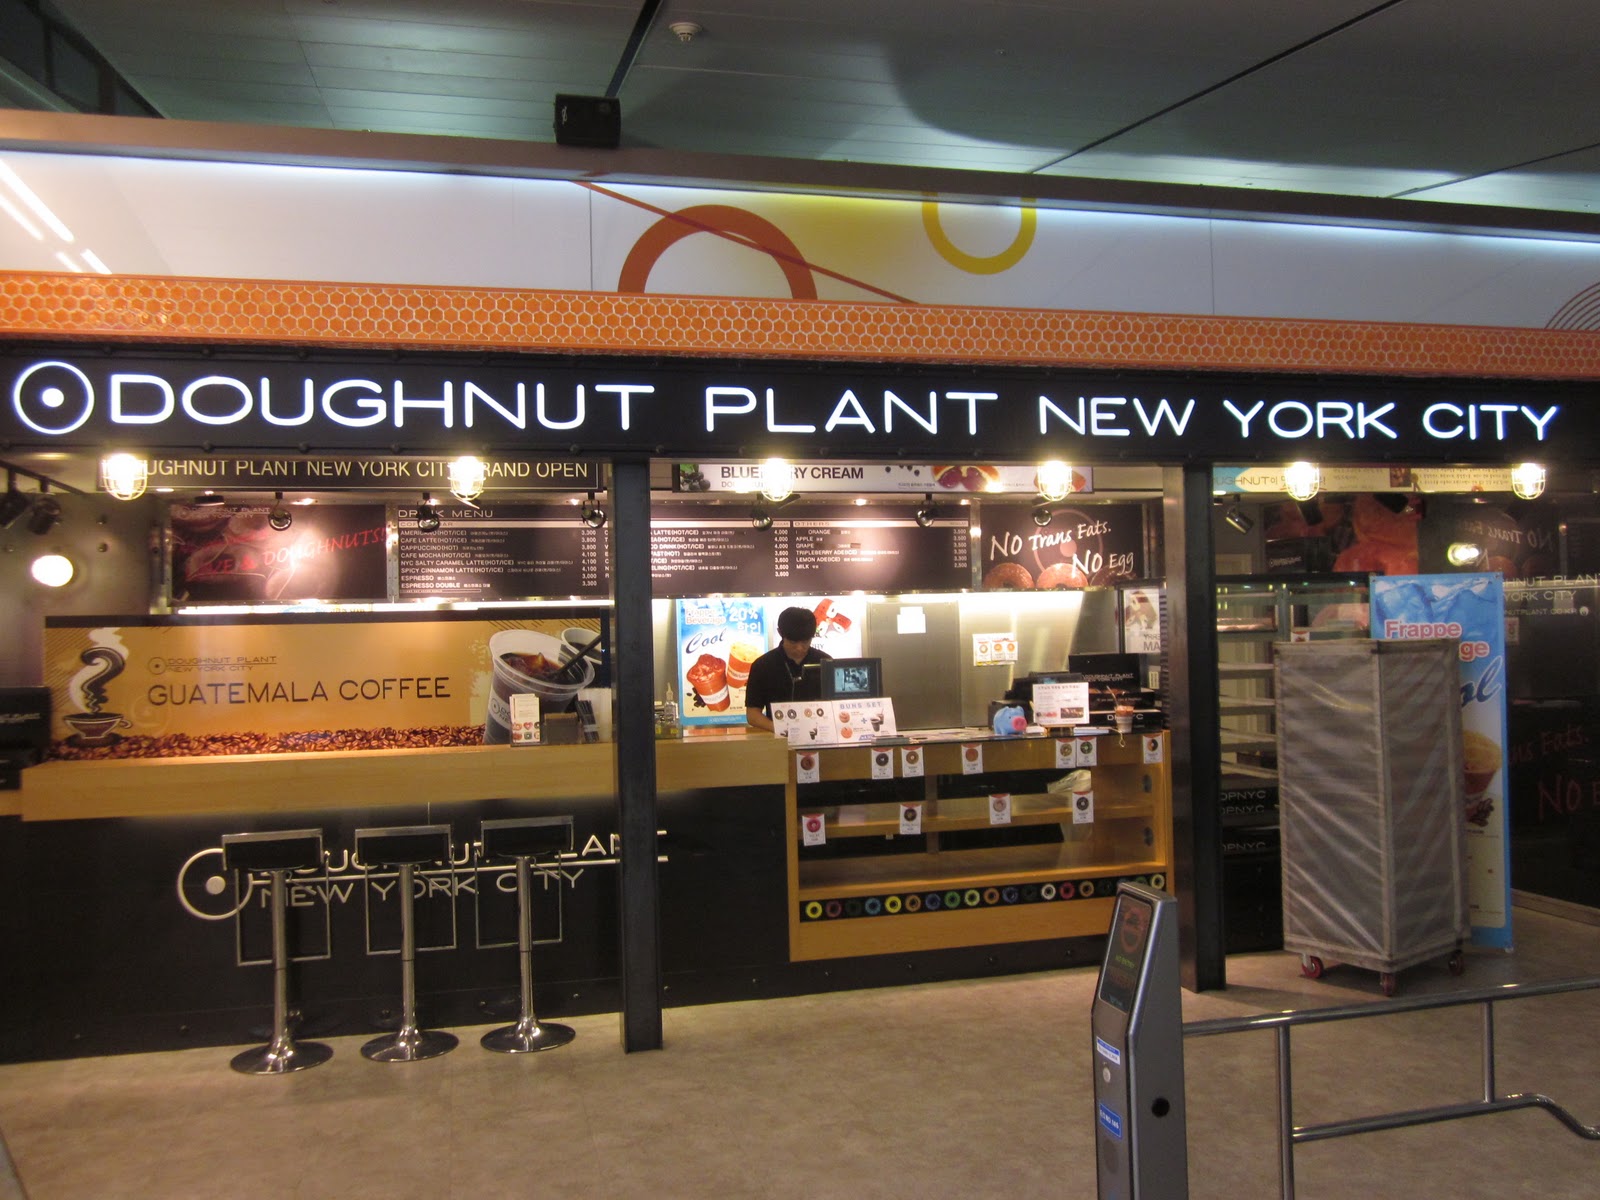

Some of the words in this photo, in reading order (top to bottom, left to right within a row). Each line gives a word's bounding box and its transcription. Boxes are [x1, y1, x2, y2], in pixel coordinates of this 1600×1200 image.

[108, 372, 655, 432] DOUGHNUT
[705, 386, 998, 436] PLANT
[1037, 396, 1196, 438] NEW
[1222, 398, 1398, 440] YORK
[1421, 402, 1559, 442] CITY
[147, 460, 228, 476] UGHNUT
[235, 460, 301, 476] PLANT
[306, 461, 352, 477] NEW
[358, 461, 410, 477] YORK
[416, 461, 450, 477] CIT
[482, 462, 530, 477] RAND
[536, 462, 588, 478] OPEN
[721, 466, 808, 479] BLUERY
[810, 466, 864, 479] CREAM
[398, 509, 444, 518] DRK
[451, 509, 493, 518] MENU
[989, 531, 1023, 561] NO
[1028, 530, 1073, 551] Trans
[1077, 520, 1112, 540] Fats.
[1071, 549, 1103, 578] NO
[1109, 552, 1134, 576] Egg
[1553, 573, 1600, 586] PLAN
[1543, 590, 1577, 601] CITY
[729, 608, 759, 622] 20%
[1385, 620, 1462, 639] Frappe
[685, 628, 727, 654] Cool
[167, 657, 231, 665] DOUGHNUT
[237, 656, 277, 664] PLANT
[147, 680, 330, 707] GUATEMALA
[338, 676, 452, 702] COFFEE
[1537, 774, 1583, 823] NO
[496, 868, 585, 893] CTY
